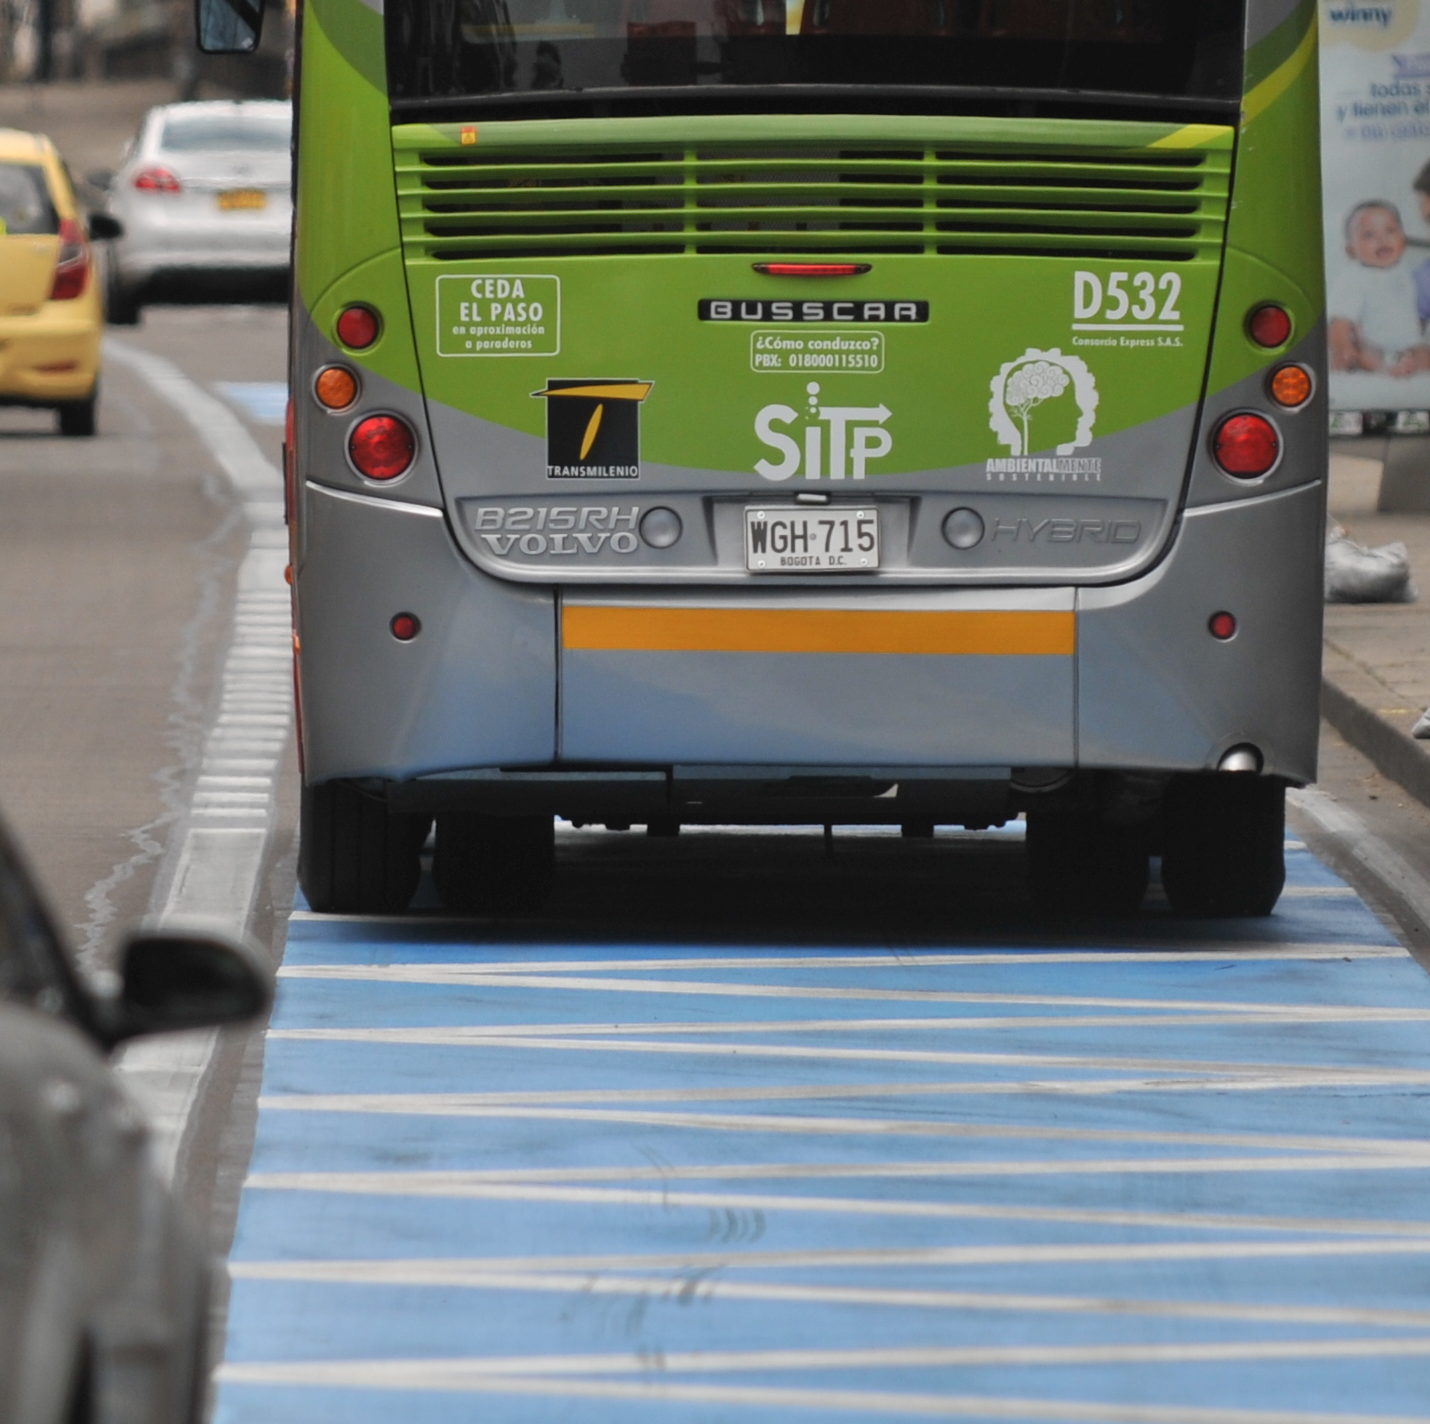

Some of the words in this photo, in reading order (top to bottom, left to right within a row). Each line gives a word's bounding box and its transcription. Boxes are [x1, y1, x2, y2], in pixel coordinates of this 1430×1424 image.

[1330, 2, 1391, 28] winny
[1371, 80, 1421, 96] todas
[1354, 101, 1409, 116] tienen
[1414, 99, 1429, 114] el
[471, 279, 524, 298] CEDA
[1074, 271, 1181, 320] D532
[460, 303, 481, 322] EL
[491, 302, 543, 322] PASO
[710, 301, 917, 321] BUSSCAR
[453, 326, 467, 335] en
[470, 324, 545, 337] aproximación
[465, 341, 472, 349] a
[476, 338, 532, 352] paraderos
[756, 336, 804, 350] ¿Cómo
[808, 336, 879, 350] conduzco?
[1072, 336, 1117, 347] Consorcio
[1120, 336, 1155, 349] Express
[1157, 336, 1183, 347] S.A.S.
[755, 354, 781, 367] PBX:
[789, 354, 878, 368] 018000115510
[547, 465, 638, 477] TRANSMILENIO
[986, 457, 1102, 473] AMBIENTALMENTE
[474, 506, 640, 531] B215RH
[991, 517, 1141, 544] HYBRID
[481, 532, 639, 555] VOLVO
[780, 556, 821, 566] BOGOTA
